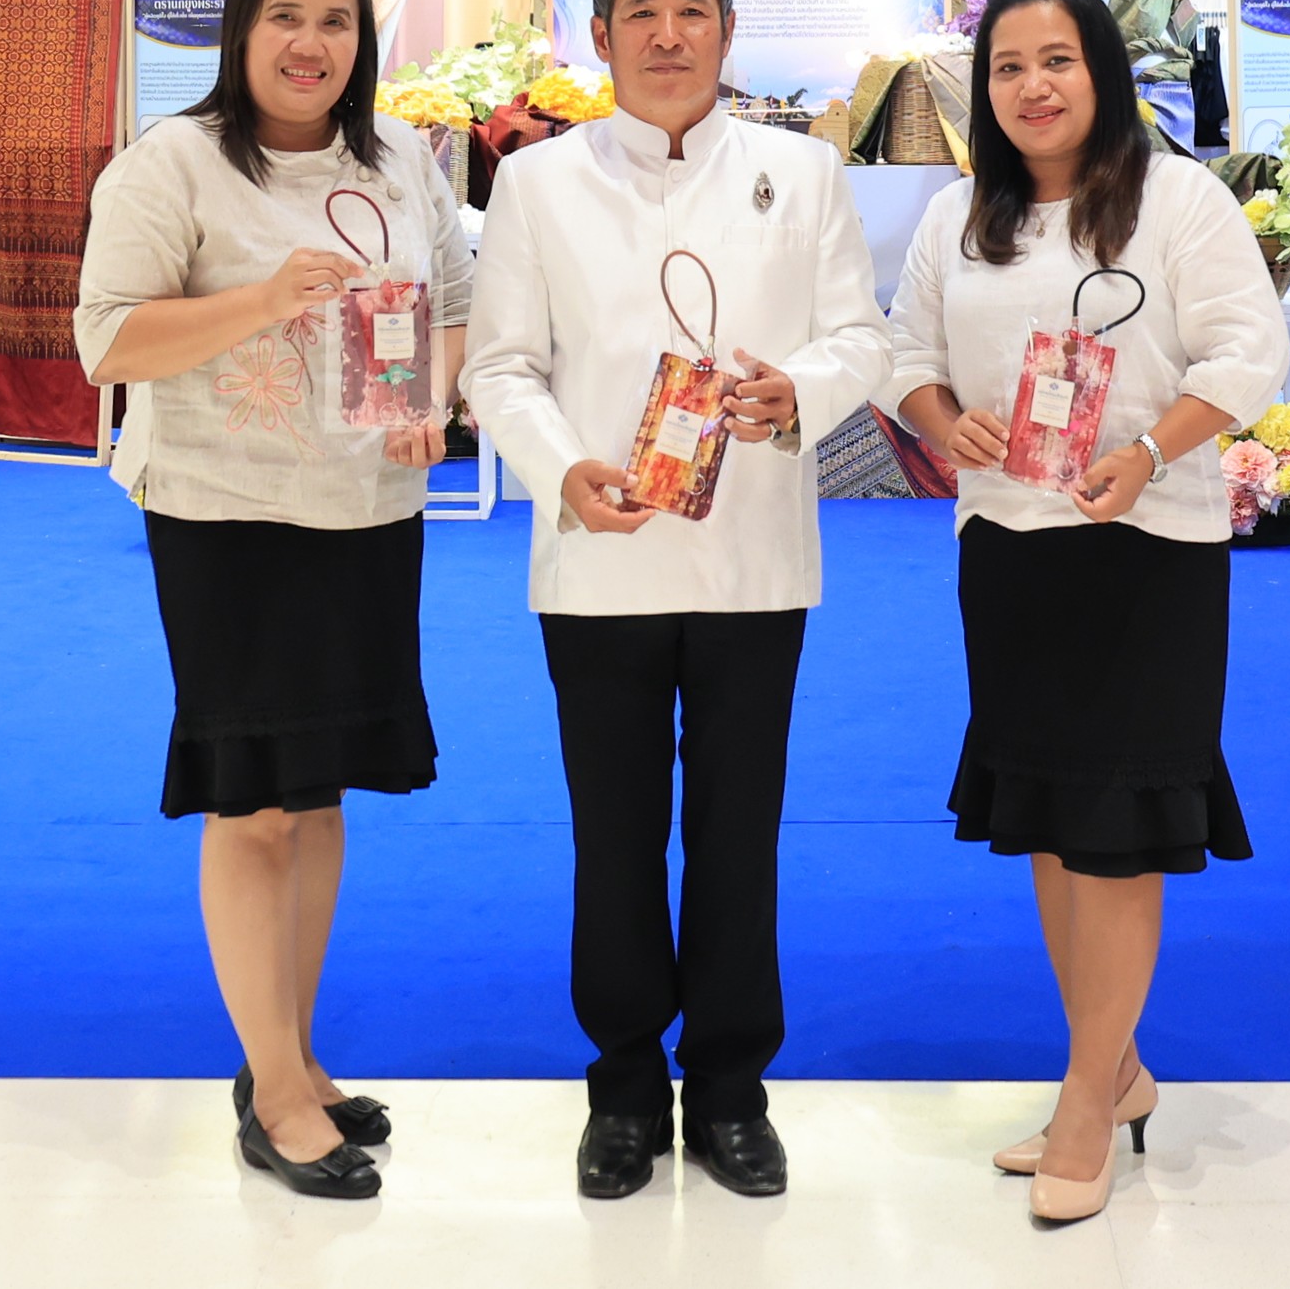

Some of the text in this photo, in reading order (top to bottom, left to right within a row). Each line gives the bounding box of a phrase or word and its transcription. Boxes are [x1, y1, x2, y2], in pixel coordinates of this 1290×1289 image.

[154, 0, 224, 13] ตรานกยูงพระรา
